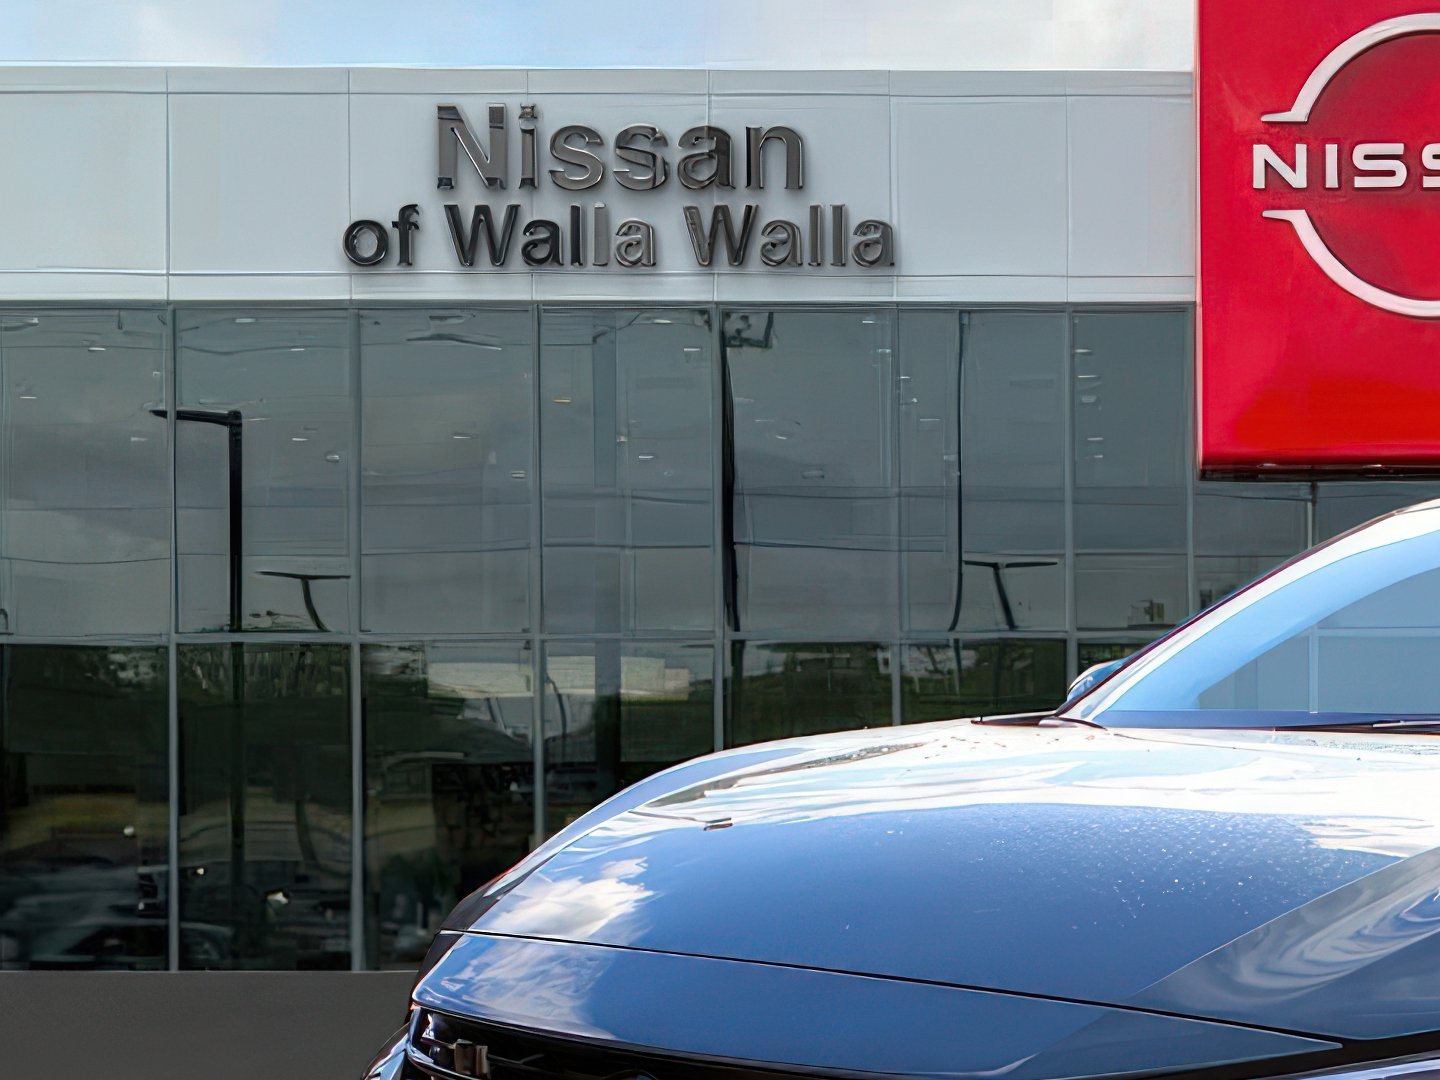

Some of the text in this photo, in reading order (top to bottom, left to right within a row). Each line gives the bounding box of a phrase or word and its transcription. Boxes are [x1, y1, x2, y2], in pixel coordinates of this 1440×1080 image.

[437, 102, 803, 190] Nissan
[343, 203, 895, 266] of Walla Walla
